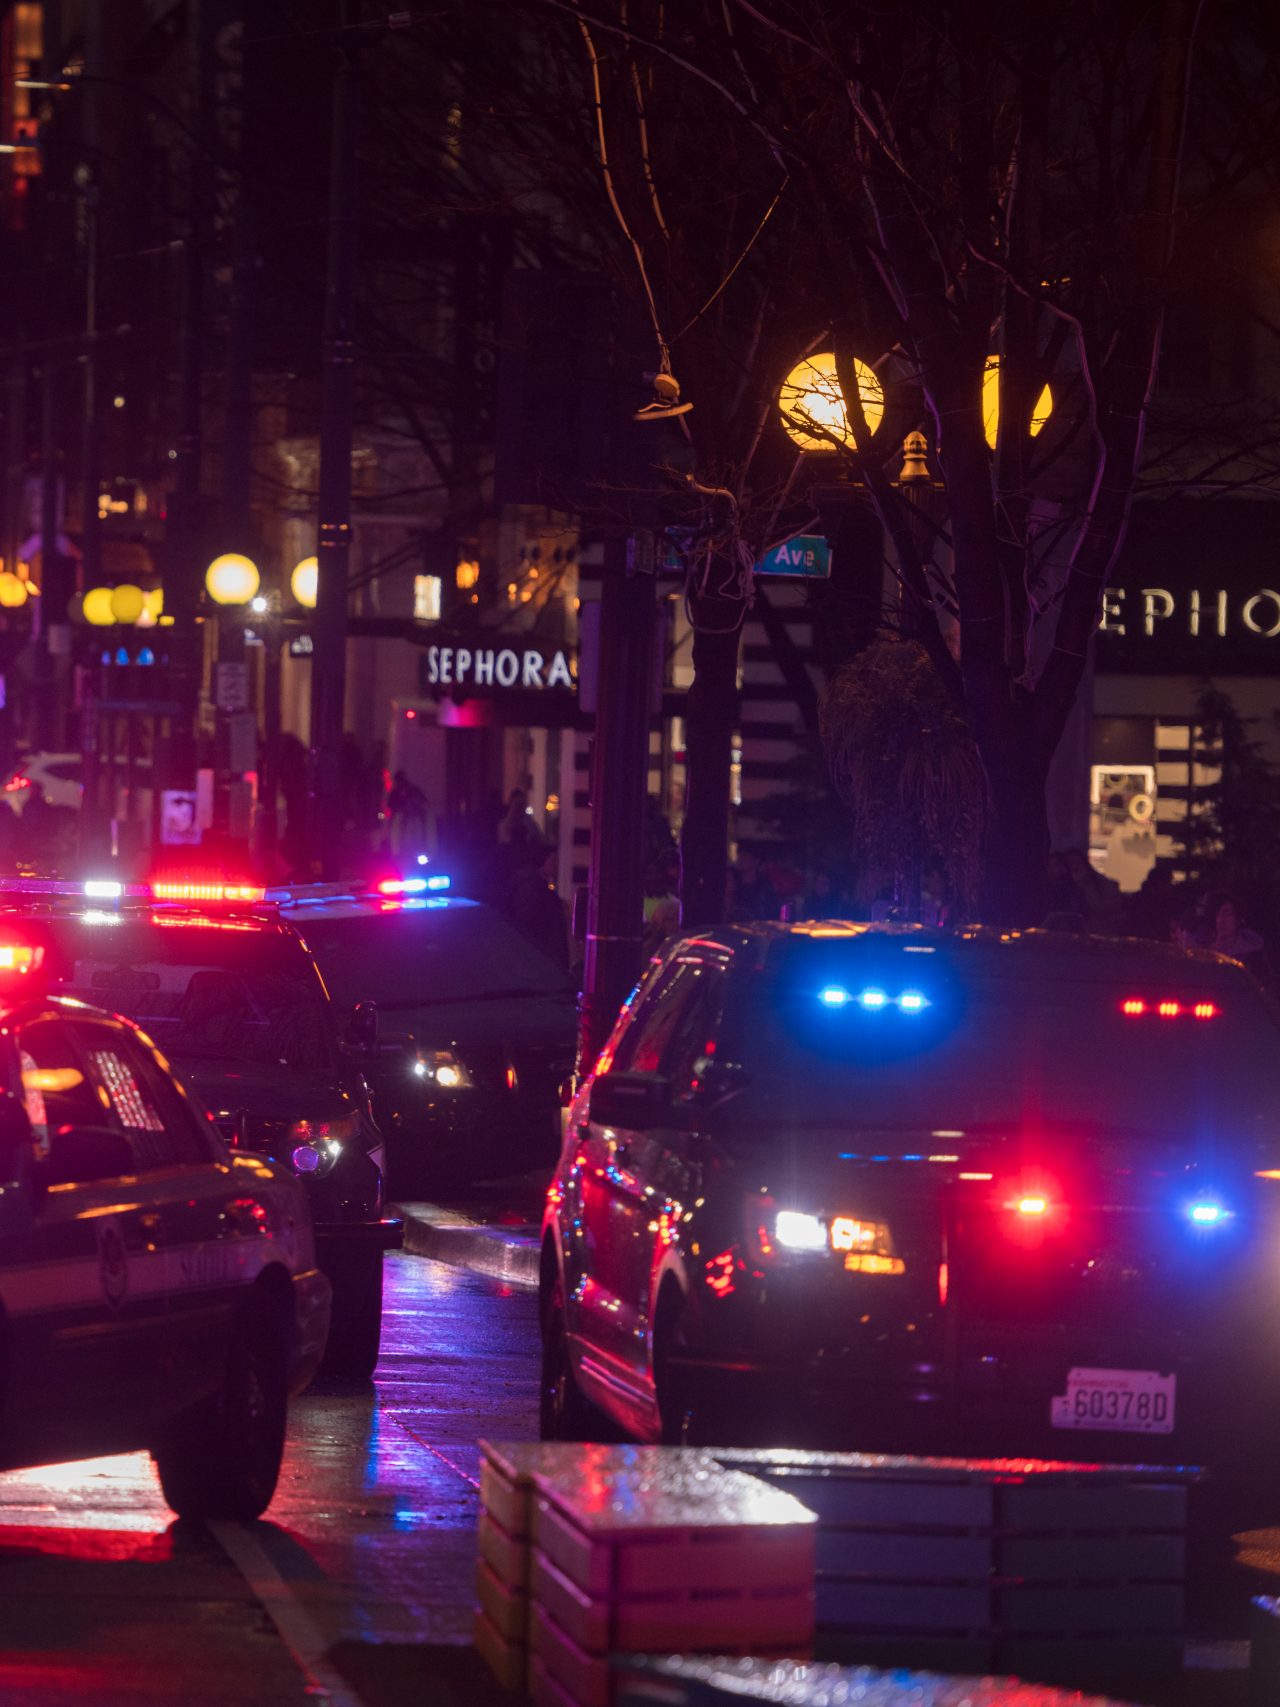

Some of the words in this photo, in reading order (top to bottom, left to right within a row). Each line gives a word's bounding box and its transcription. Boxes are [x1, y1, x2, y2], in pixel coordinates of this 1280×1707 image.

[774, 543, 816, 566] Ave
[427, 645, 573, 688] SEPHORA
[1074, 1388, 1167, 1422] 60378D
